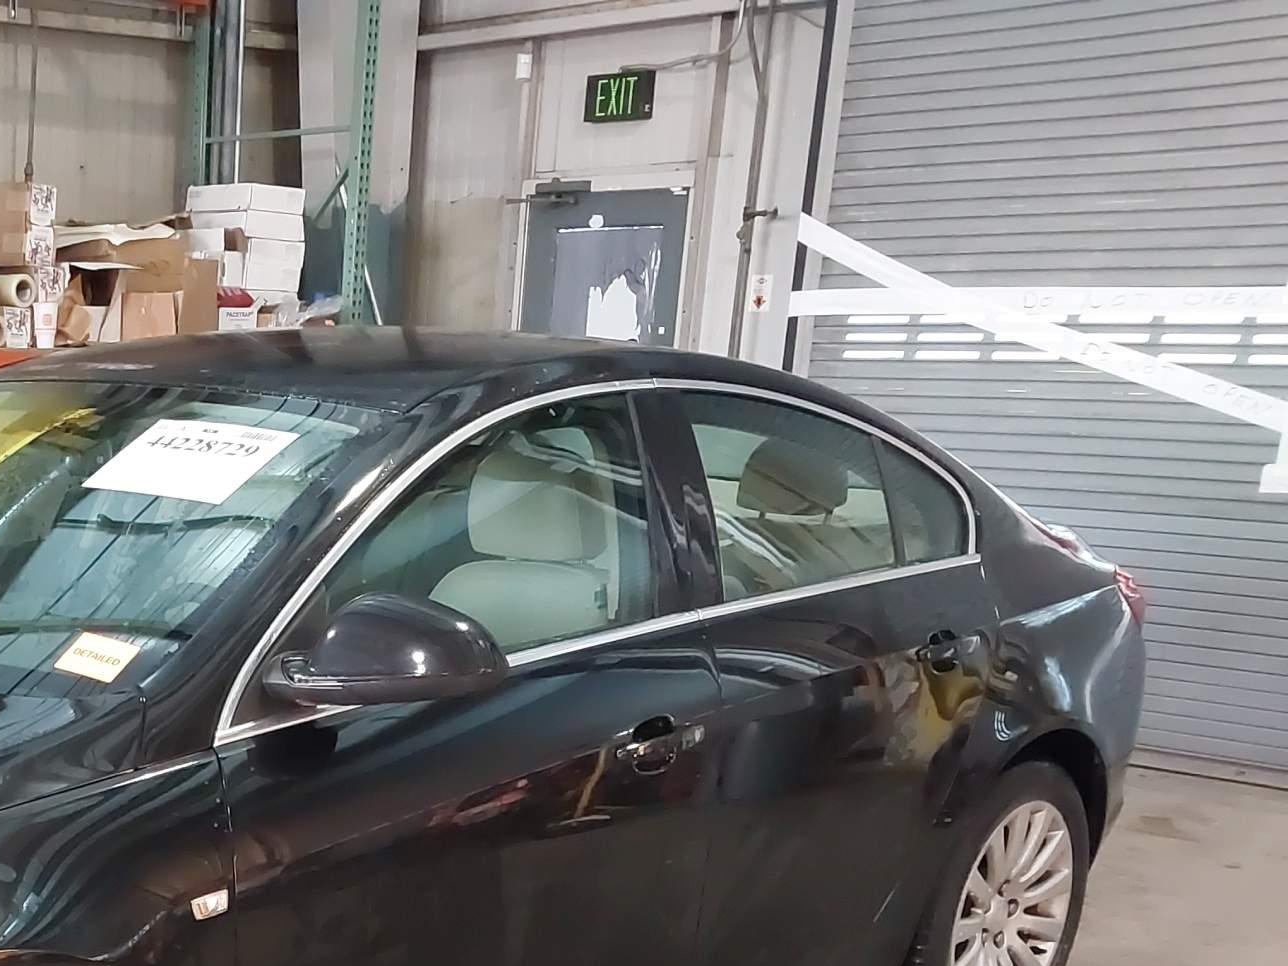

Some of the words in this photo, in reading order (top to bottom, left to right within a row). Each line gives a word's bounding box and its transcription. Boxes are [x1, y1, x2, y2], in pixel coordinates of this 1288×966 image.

[595, 76, 638, 117] EXIT
[147, 435, 261, 457] 44228729
[72, 647, 121, 666] DETAILED
